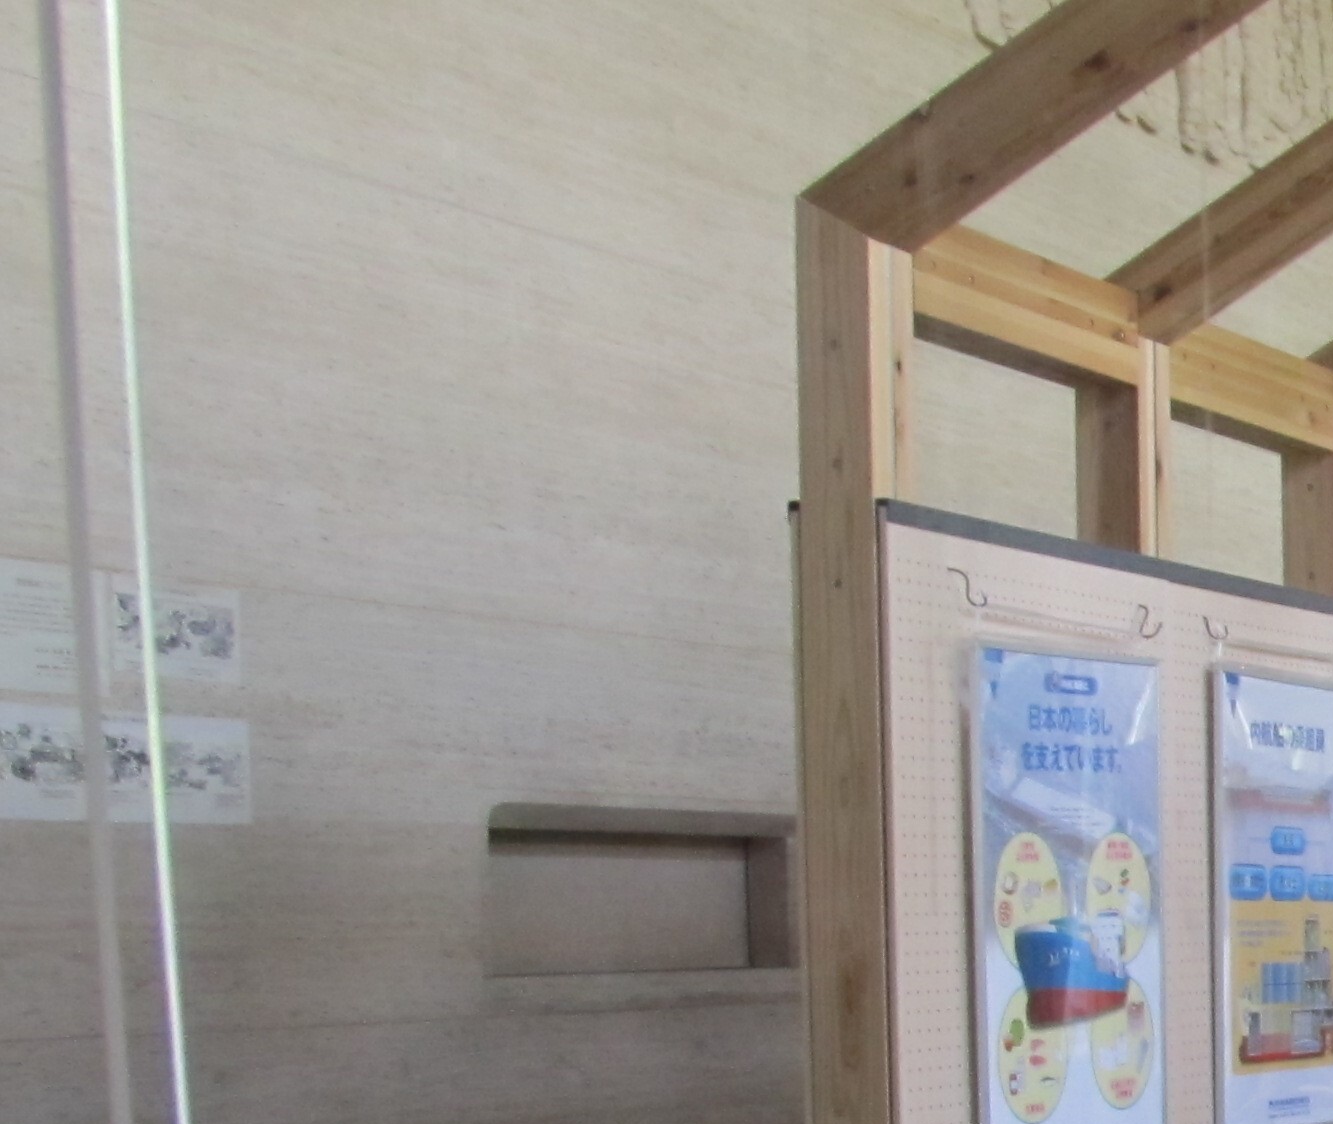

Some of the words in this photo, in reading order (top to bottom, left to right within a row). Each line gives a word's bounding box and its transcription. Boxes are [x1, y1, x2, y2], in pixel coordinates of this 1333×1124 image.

[1028, 702, 1113, 735] 日本の暮らし
